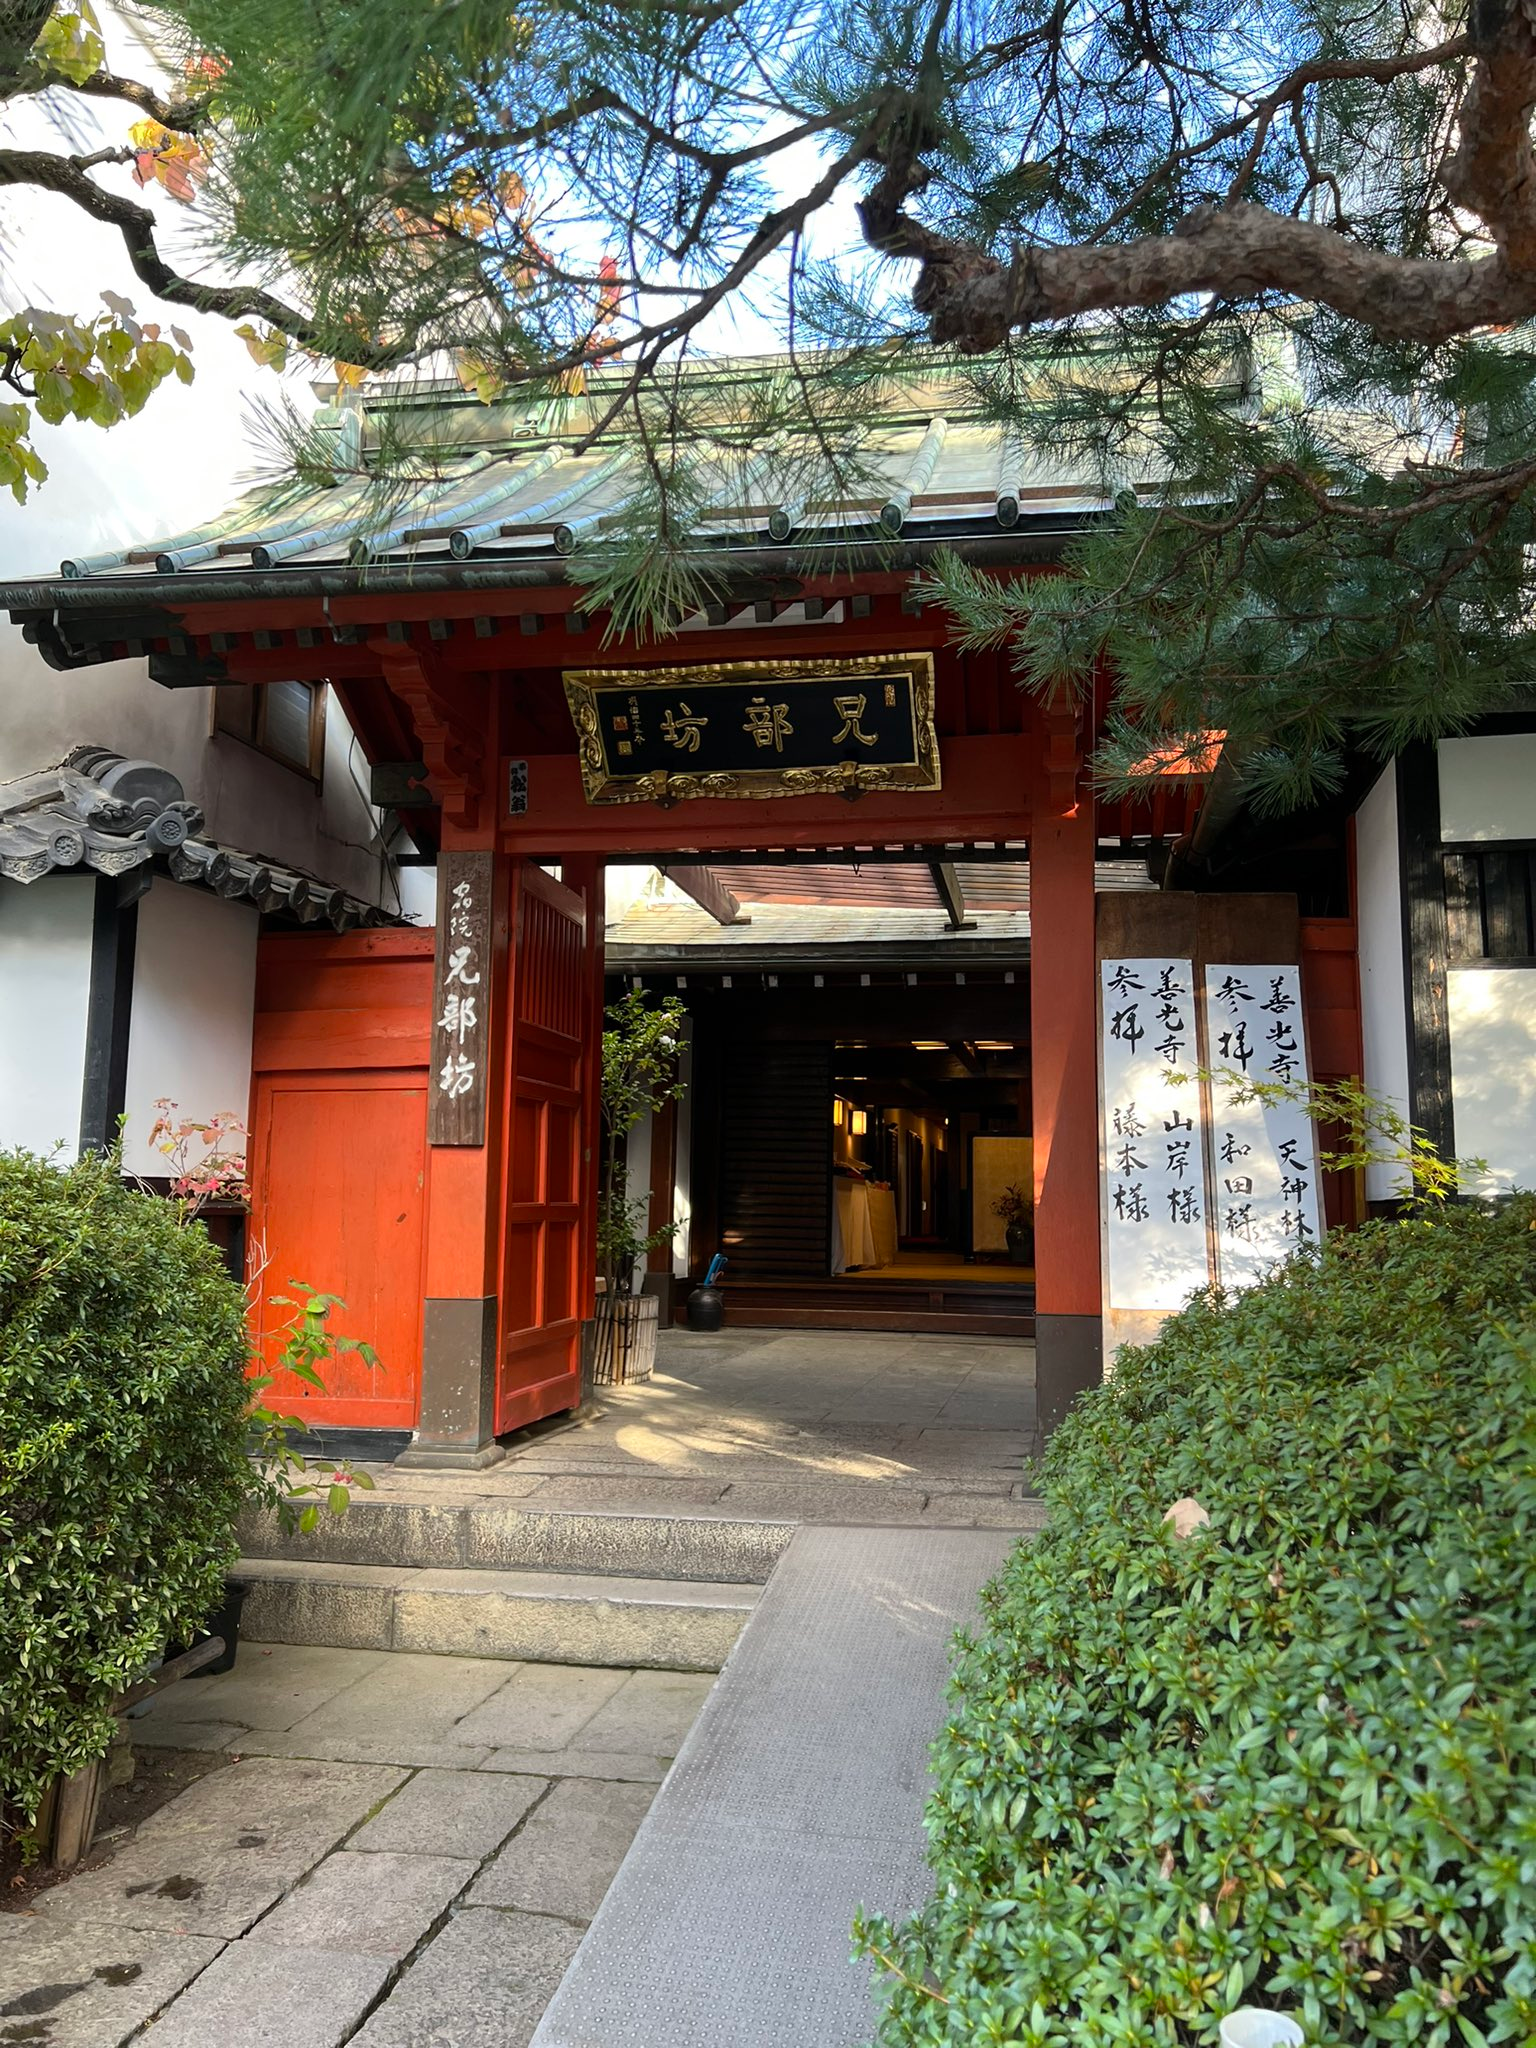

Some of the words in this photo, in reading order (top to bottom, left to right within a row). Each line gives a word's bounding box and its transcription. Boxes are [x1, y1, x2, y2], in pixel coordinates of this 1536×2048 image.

[1107, 966, 1146, 1055] 参拝
[1150, 966, 1186, 1064] 善光寺
[1215, 976, 1256, 1072] 参拝
[1260, 976, 1299, 1084] 善光寺
[1112, 1102, 1150, 1222] 藤本様
[1163, 1110, 1201, 1224] 山岸様
[1220, 1133, 1257, 1243] 和田様
